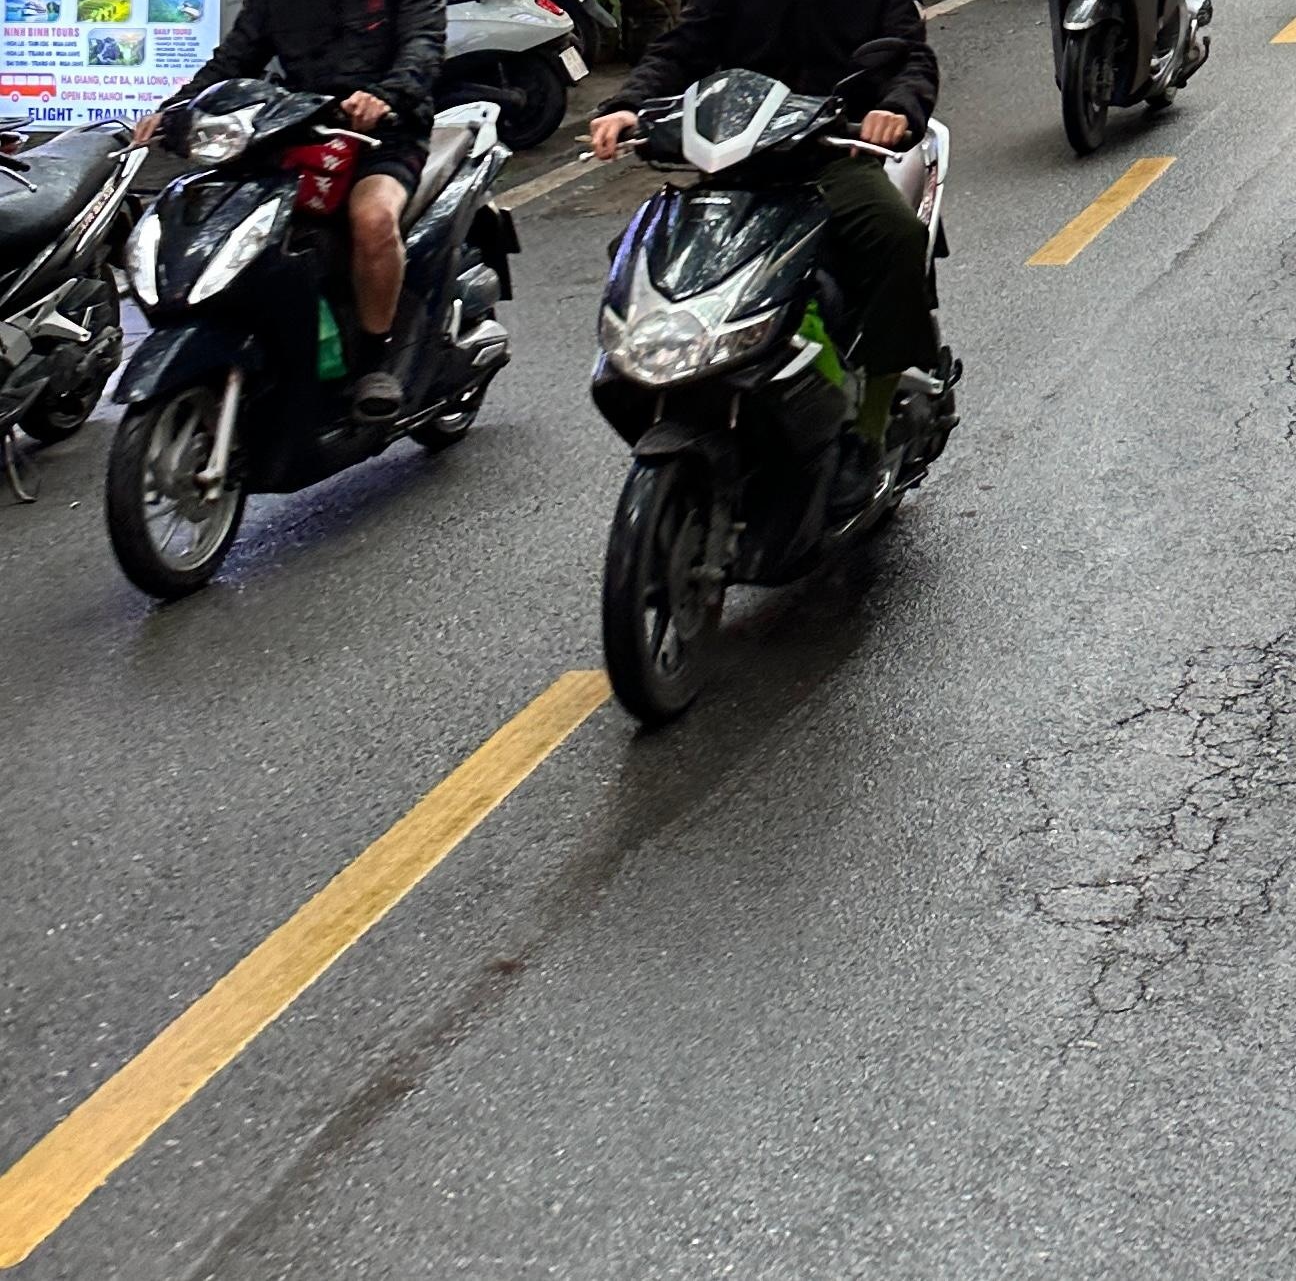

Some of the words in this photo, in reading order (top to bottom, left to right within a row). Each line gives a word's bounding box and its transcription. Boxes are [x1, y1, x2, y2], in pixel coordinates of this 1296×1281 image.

[4, 27, 26, 37] NINH
[28, 27, 49, 37] BINH
[51, 27, 80, 37] TOURS
[61, 75, 72, 84] HA
[103, 75, 119, 84] CAT
[134, 76, 145, 84] HA
[147, 76, 170, 86] LONG,
[61, 91, 80, 101] OPEN
[82, 91, 97, 101] BUS
[99, 91, 123, 101] HANOI
[138, 92, 152, 101] HUE
[28, 108, 73, 121] FLIGHT
[87, 108, 128, 122] TRAIN
